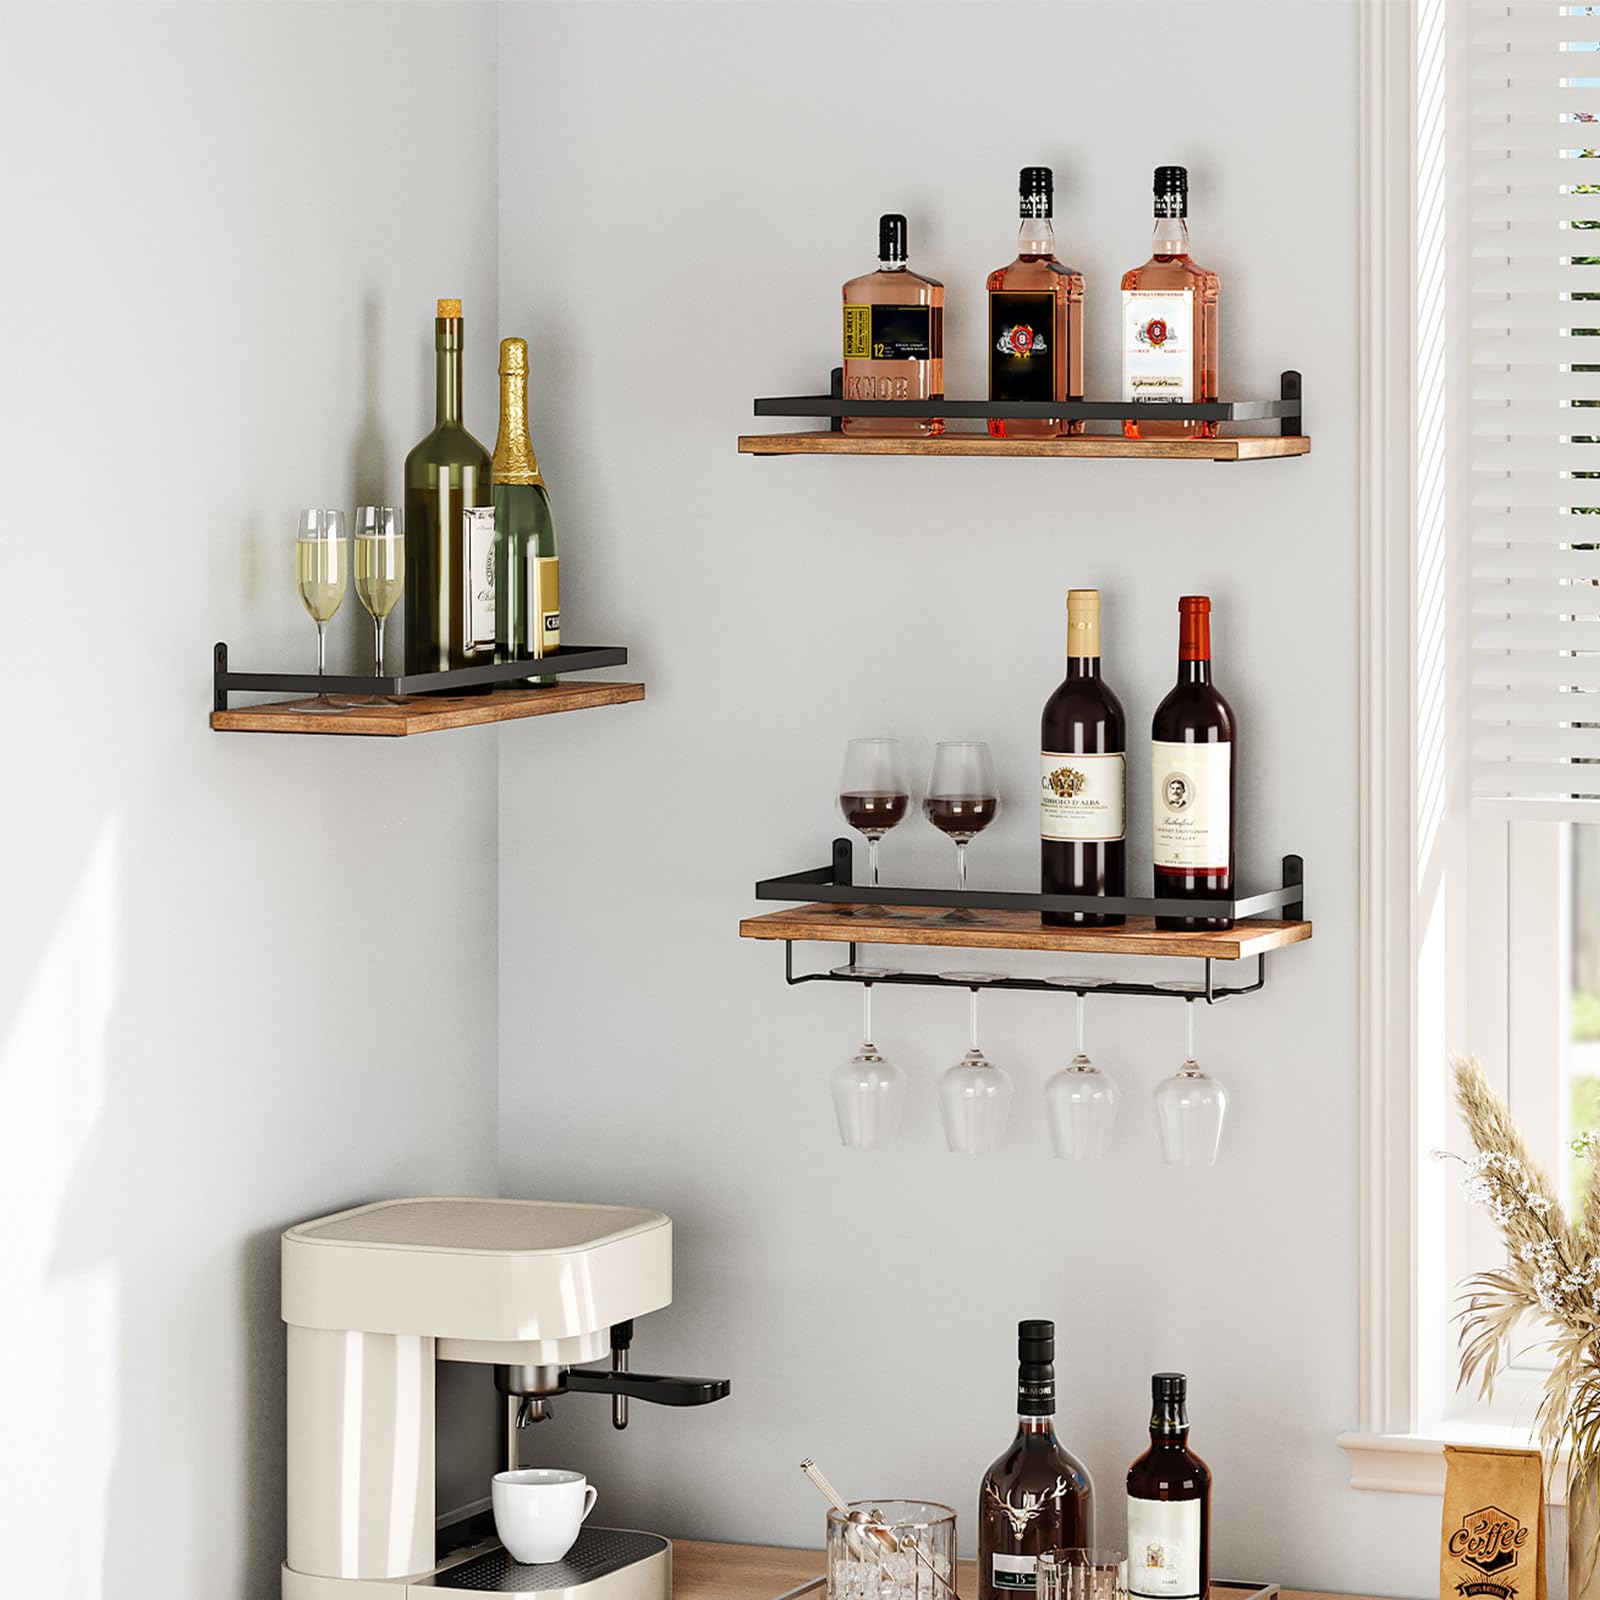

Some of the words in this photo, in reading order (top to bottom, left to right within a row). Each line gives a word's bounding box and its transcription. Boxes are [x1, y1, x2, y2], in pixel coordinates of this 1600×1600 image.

[874, 343, 885, 358] 12
[847, 376, 908, 400] KNOB
[1449, 1521, 1529, 1557] Coffee
[1015, 1574, 1027, 1584] 15
